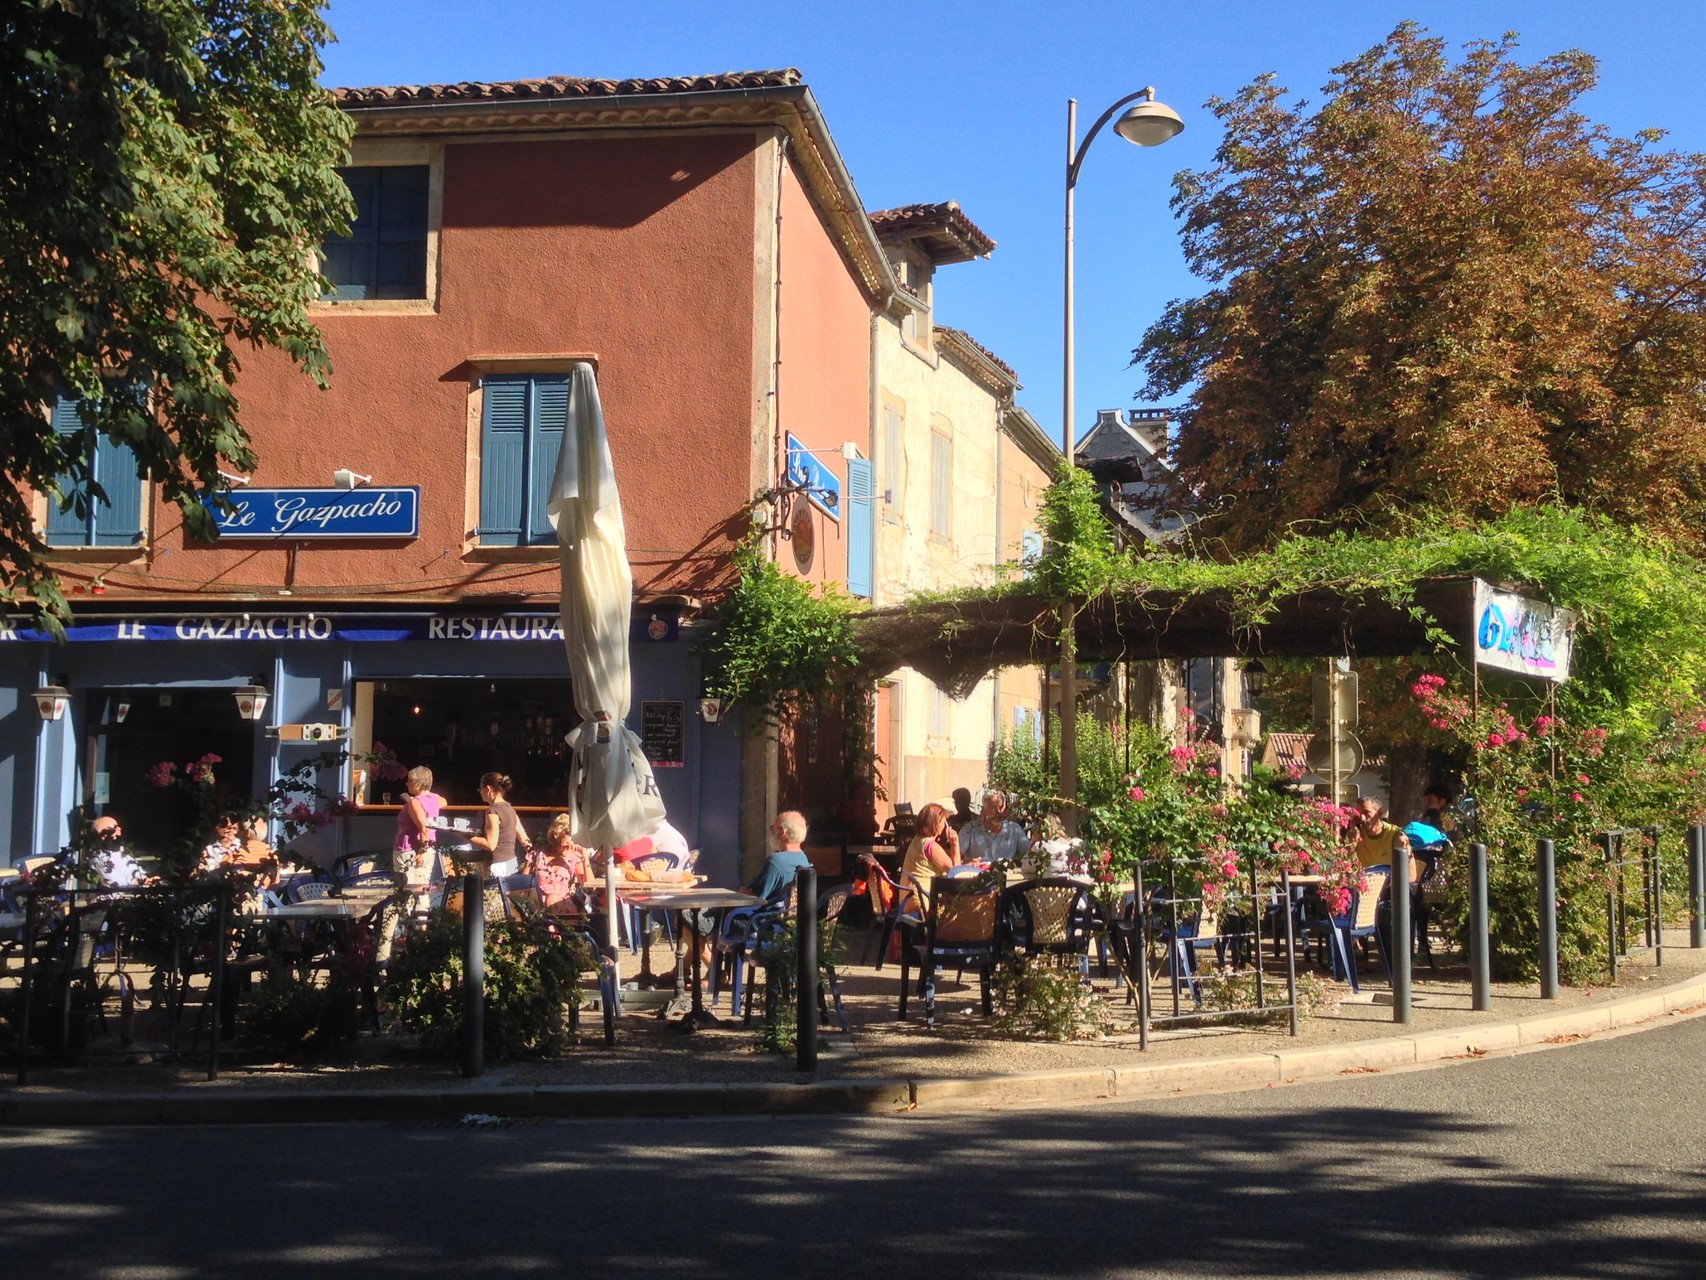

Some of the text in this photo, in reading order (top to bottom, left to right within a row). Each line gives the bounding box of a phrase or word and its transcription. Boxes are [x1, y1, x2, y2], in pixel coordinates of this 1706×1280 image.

[216, 493, 401, 532] Le Gazpacho
[117, 617, 333, 640] LE GAZPACHO
